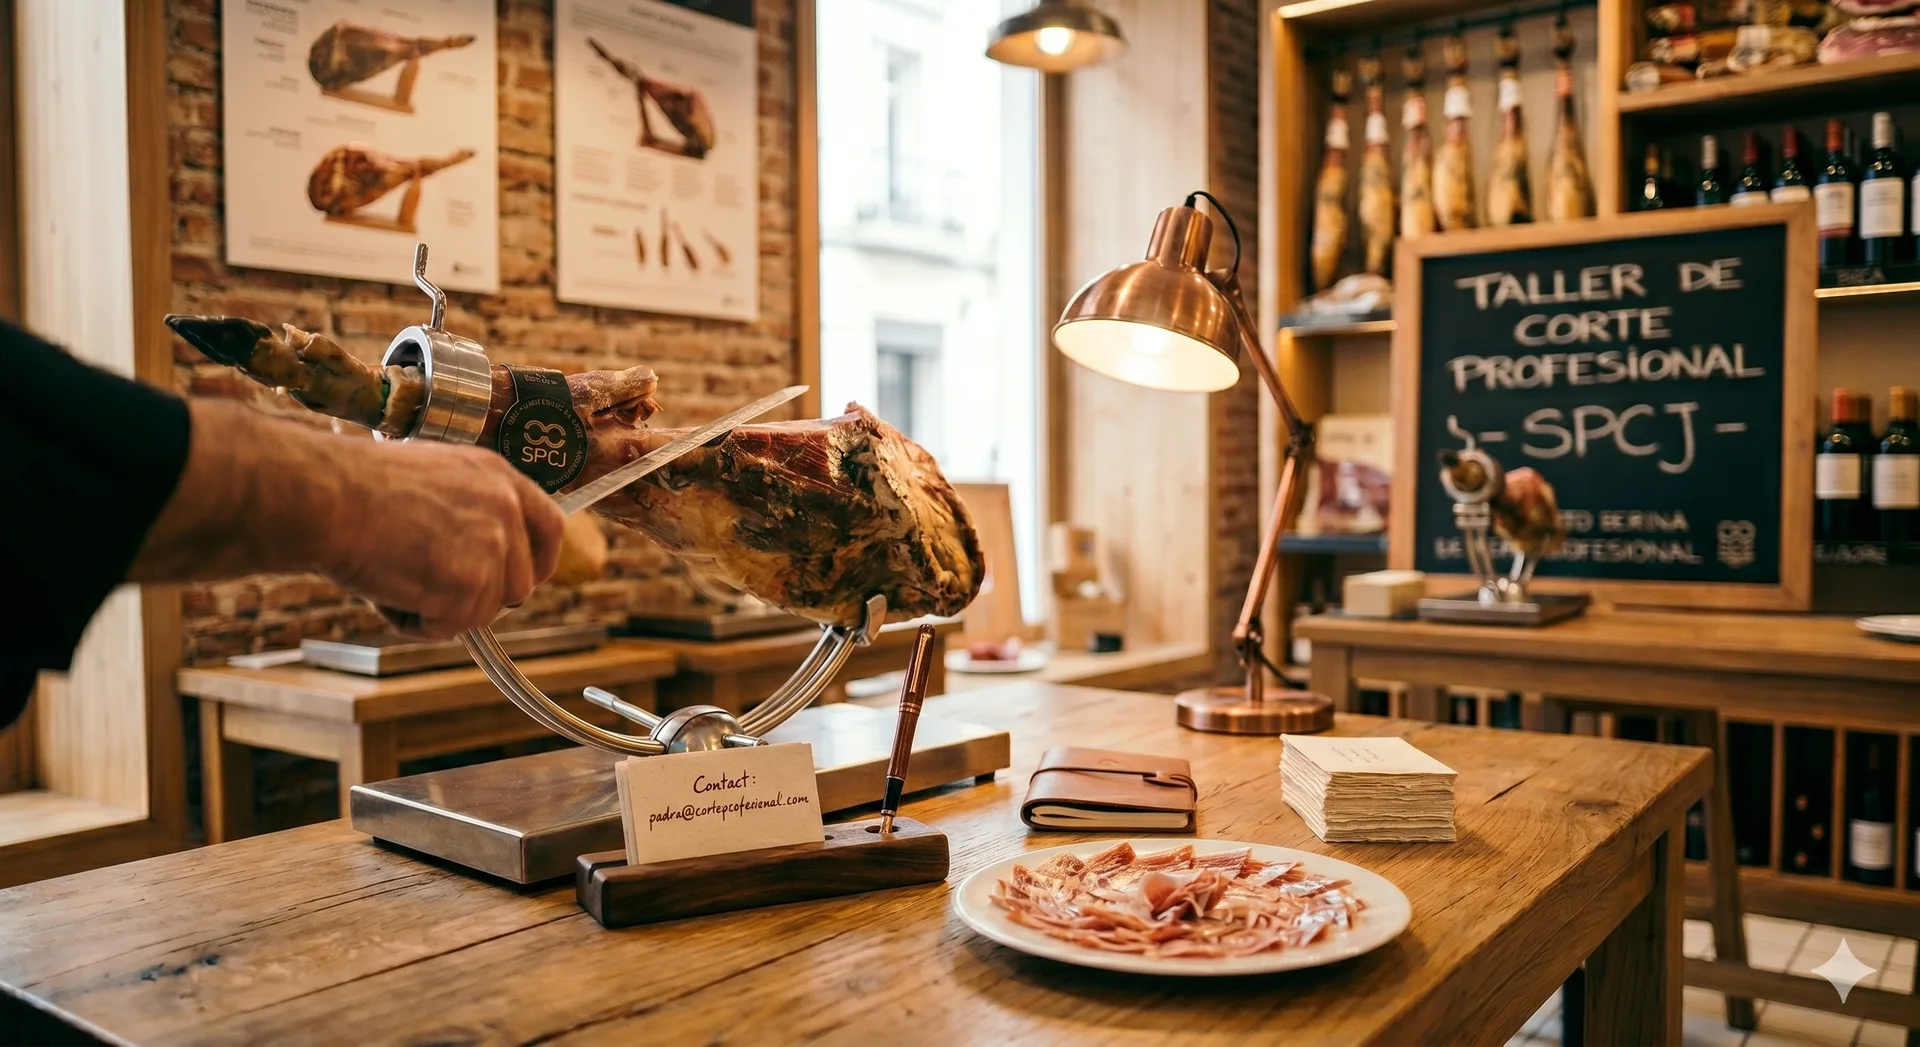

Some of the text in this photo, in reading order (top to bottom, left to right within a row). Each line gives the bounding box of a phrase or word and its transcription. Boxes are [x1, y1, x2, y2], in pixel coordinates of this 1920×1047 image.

[1456, 257, 1743, 308] TALLER DE
[1514, 306, 1673, 346] CORTE
[1446, 344, 1765, 393] PROFESIONAL
[521, 446, 567, 468] SPCJ
[1521, 401, 1699, 474] SPCJ
